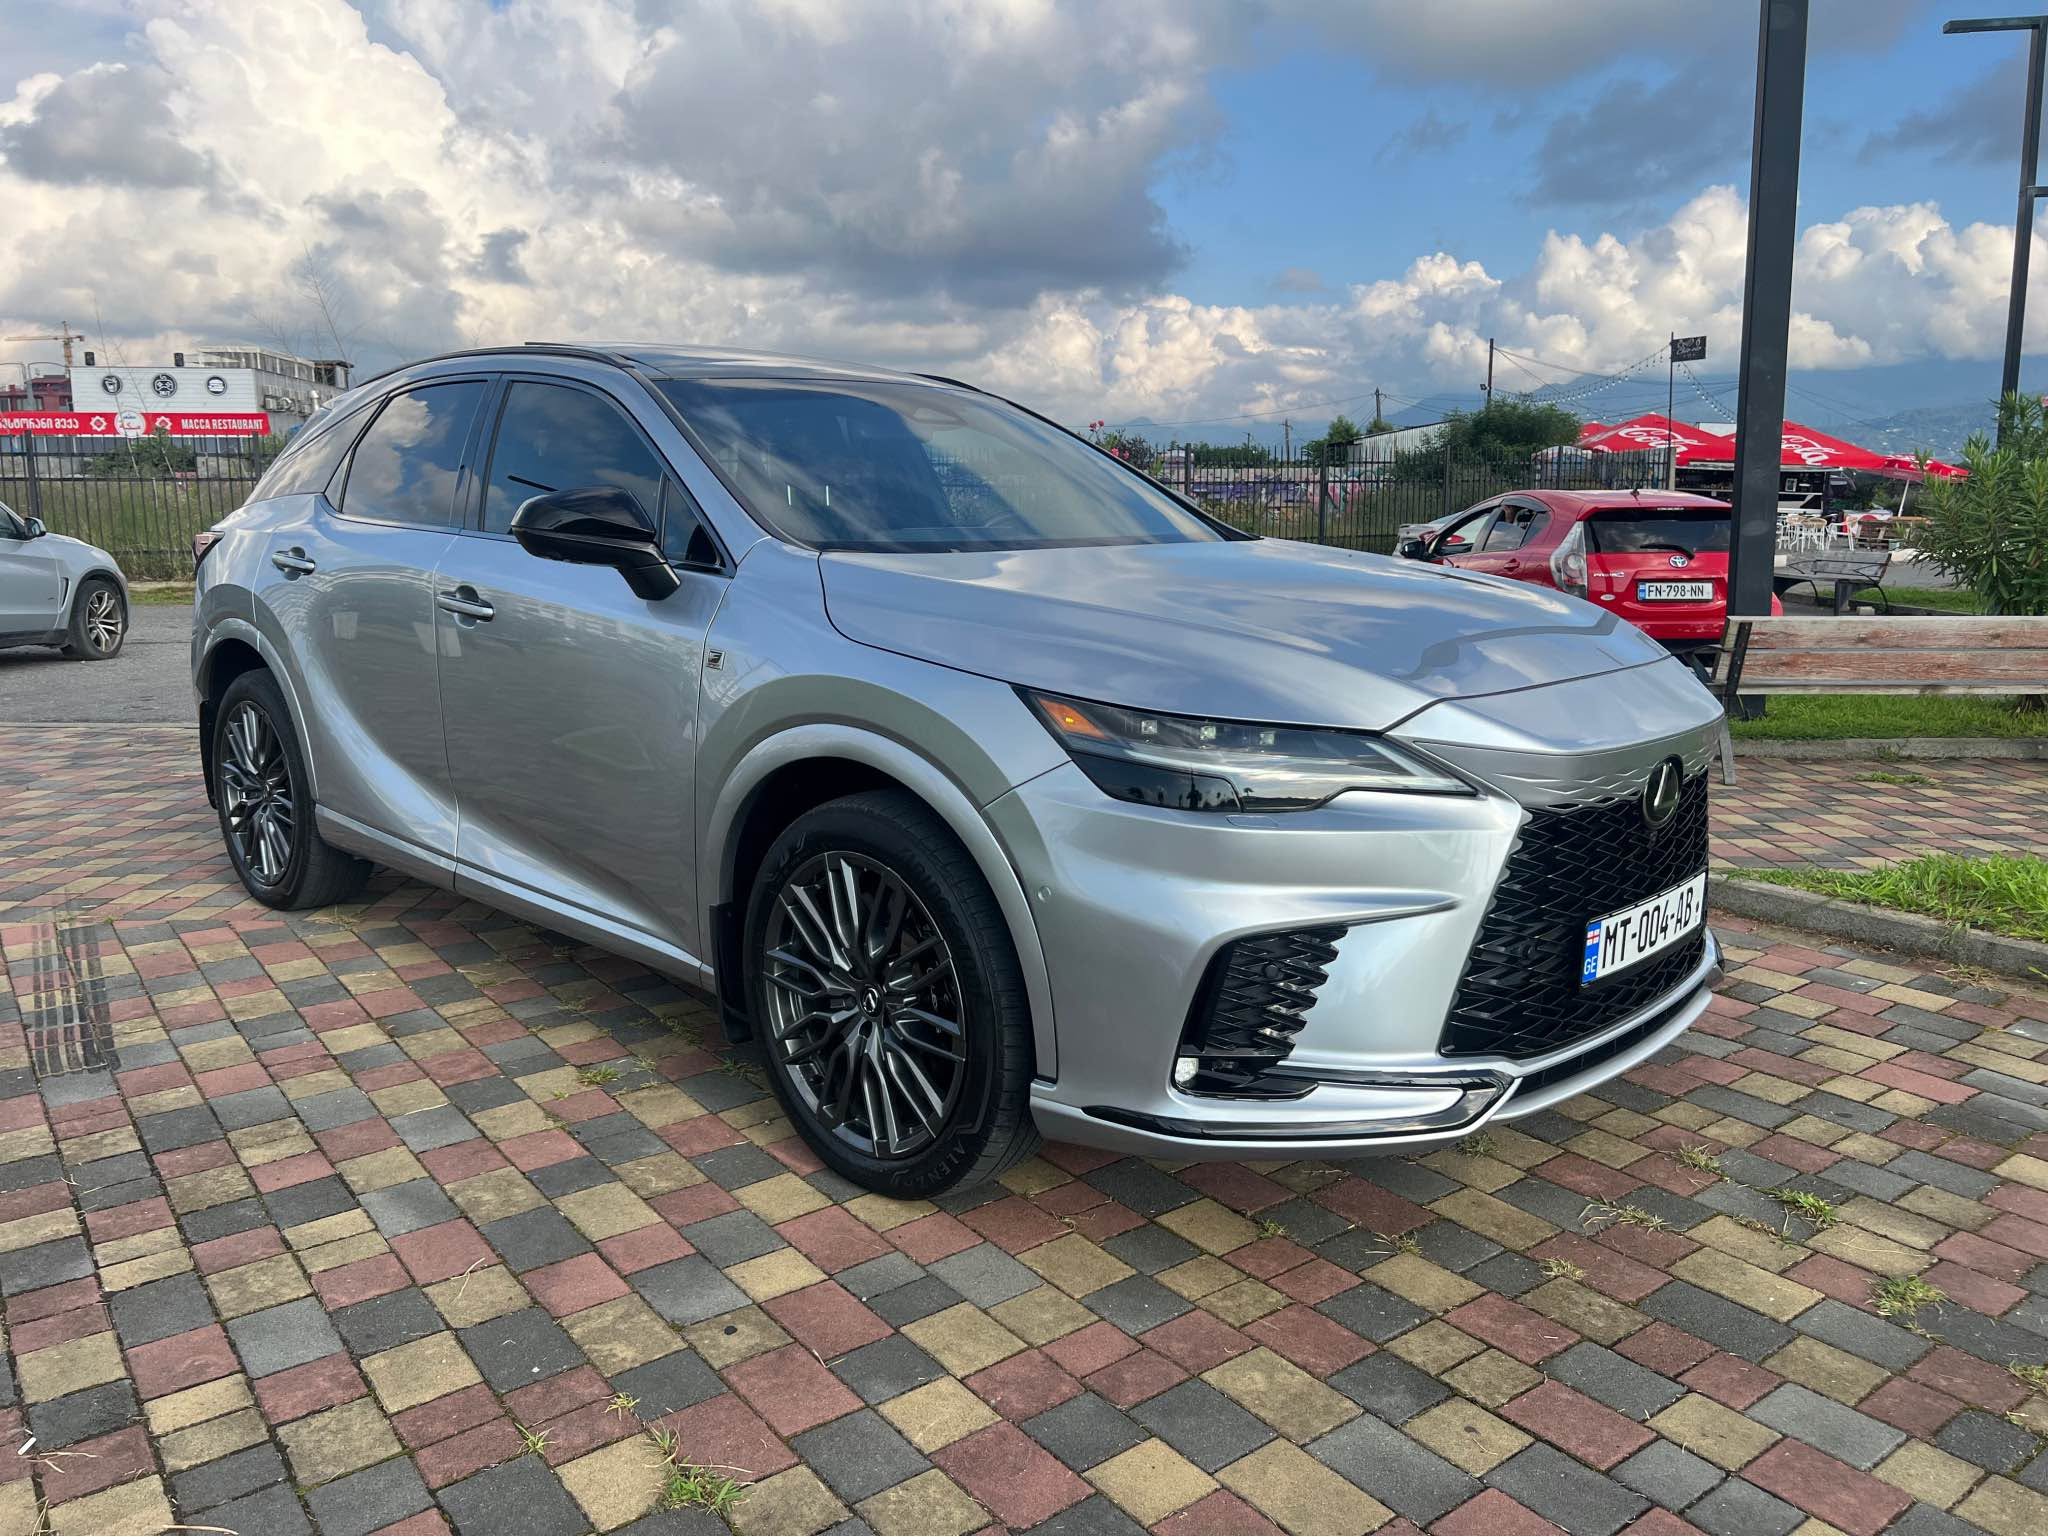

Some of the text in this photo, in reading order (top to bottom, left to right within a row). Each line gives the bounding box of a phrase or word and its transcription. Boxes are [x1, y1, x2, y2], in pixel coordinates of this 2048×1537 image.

[181, 418, 264, 429] MACCA RESTAURANT
[1647, 584, 1704, 598] FN-798-NN
[1583, 886, 1694, 975] GE MT-004-AB
